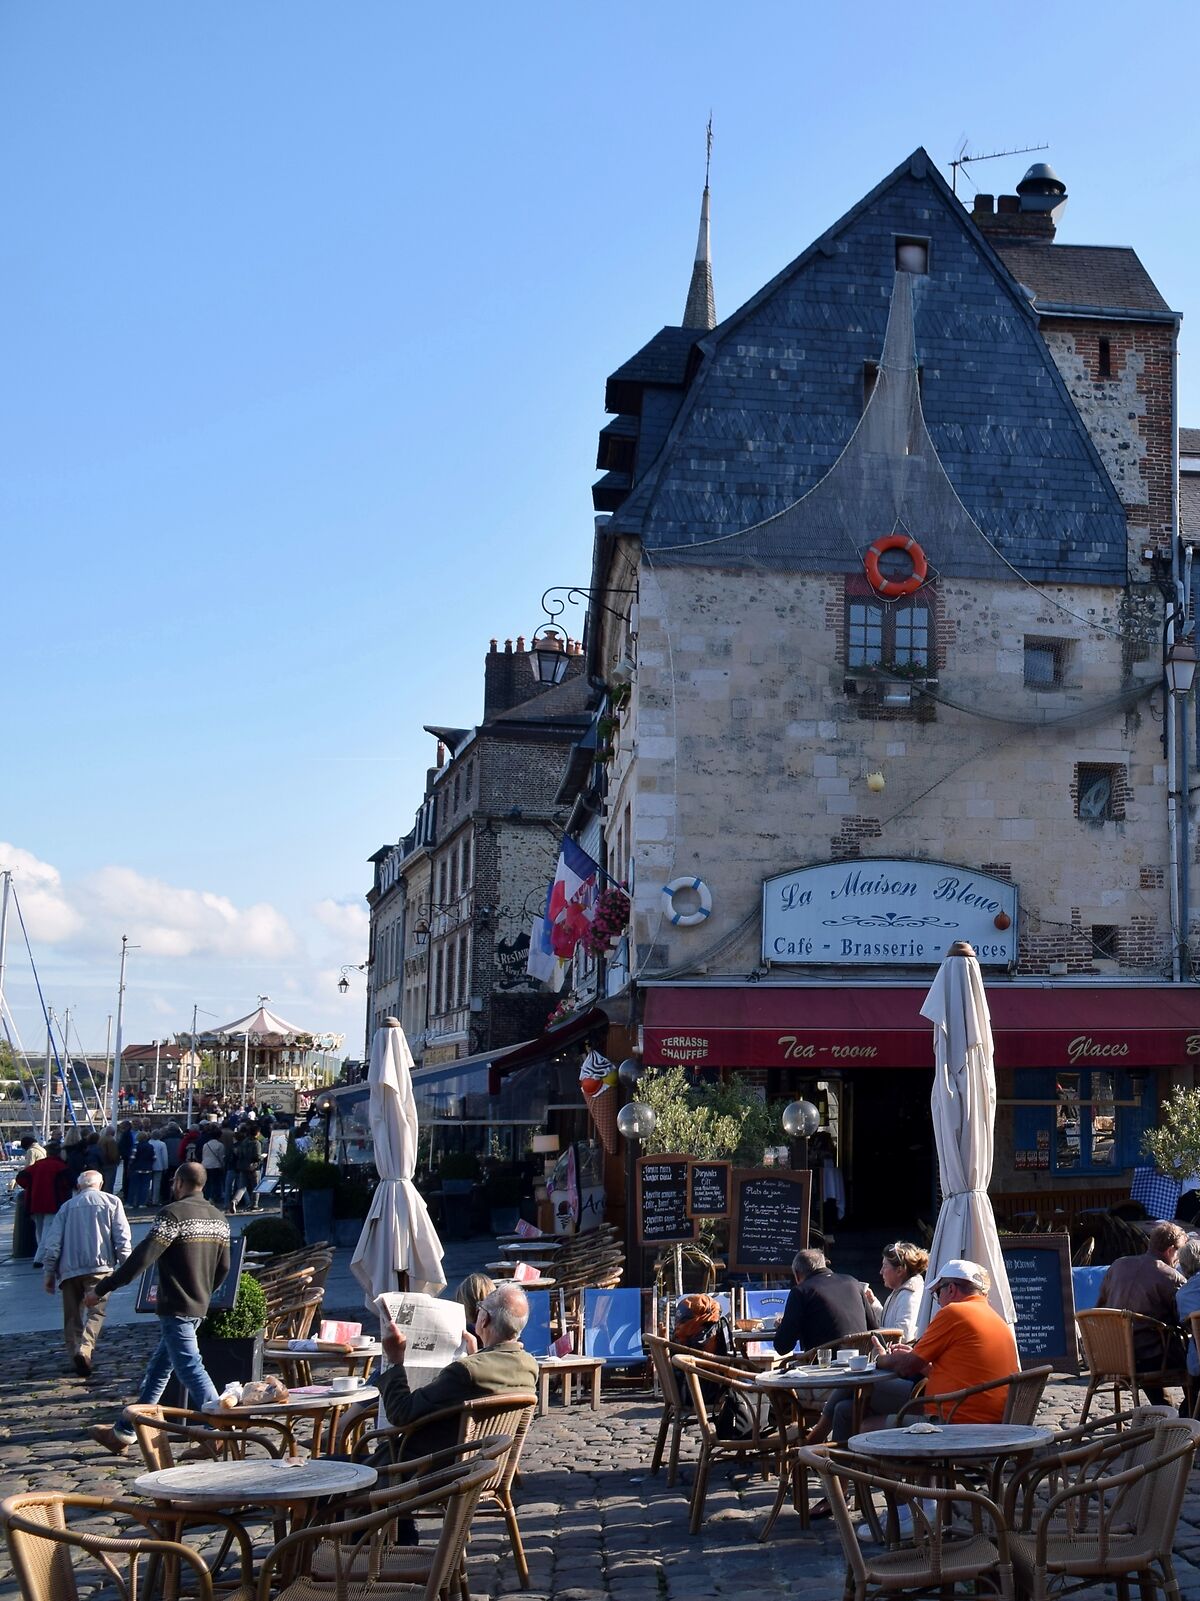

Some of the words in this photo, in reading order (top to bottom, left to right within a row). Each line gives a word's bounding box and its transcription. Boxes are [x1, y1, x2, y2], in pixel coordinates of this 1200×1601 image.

[781, 882, 812, 911] La
[831, 870, 917, 899] Maison
[933, 877, 999, 913] Bleue
[774, 936, 813, 956] Café
[840, 938, 924, 957] Brasserie
[953, 940, 1007, 957] aces
[661, 1036, 709, 1047] TERRASSE
[777, 1036, 878, 1060] Tea-room
[1067, 1035, 1130, 1064] Glaces
[661, 1047, 709, 1060] CHAUFFÉE
